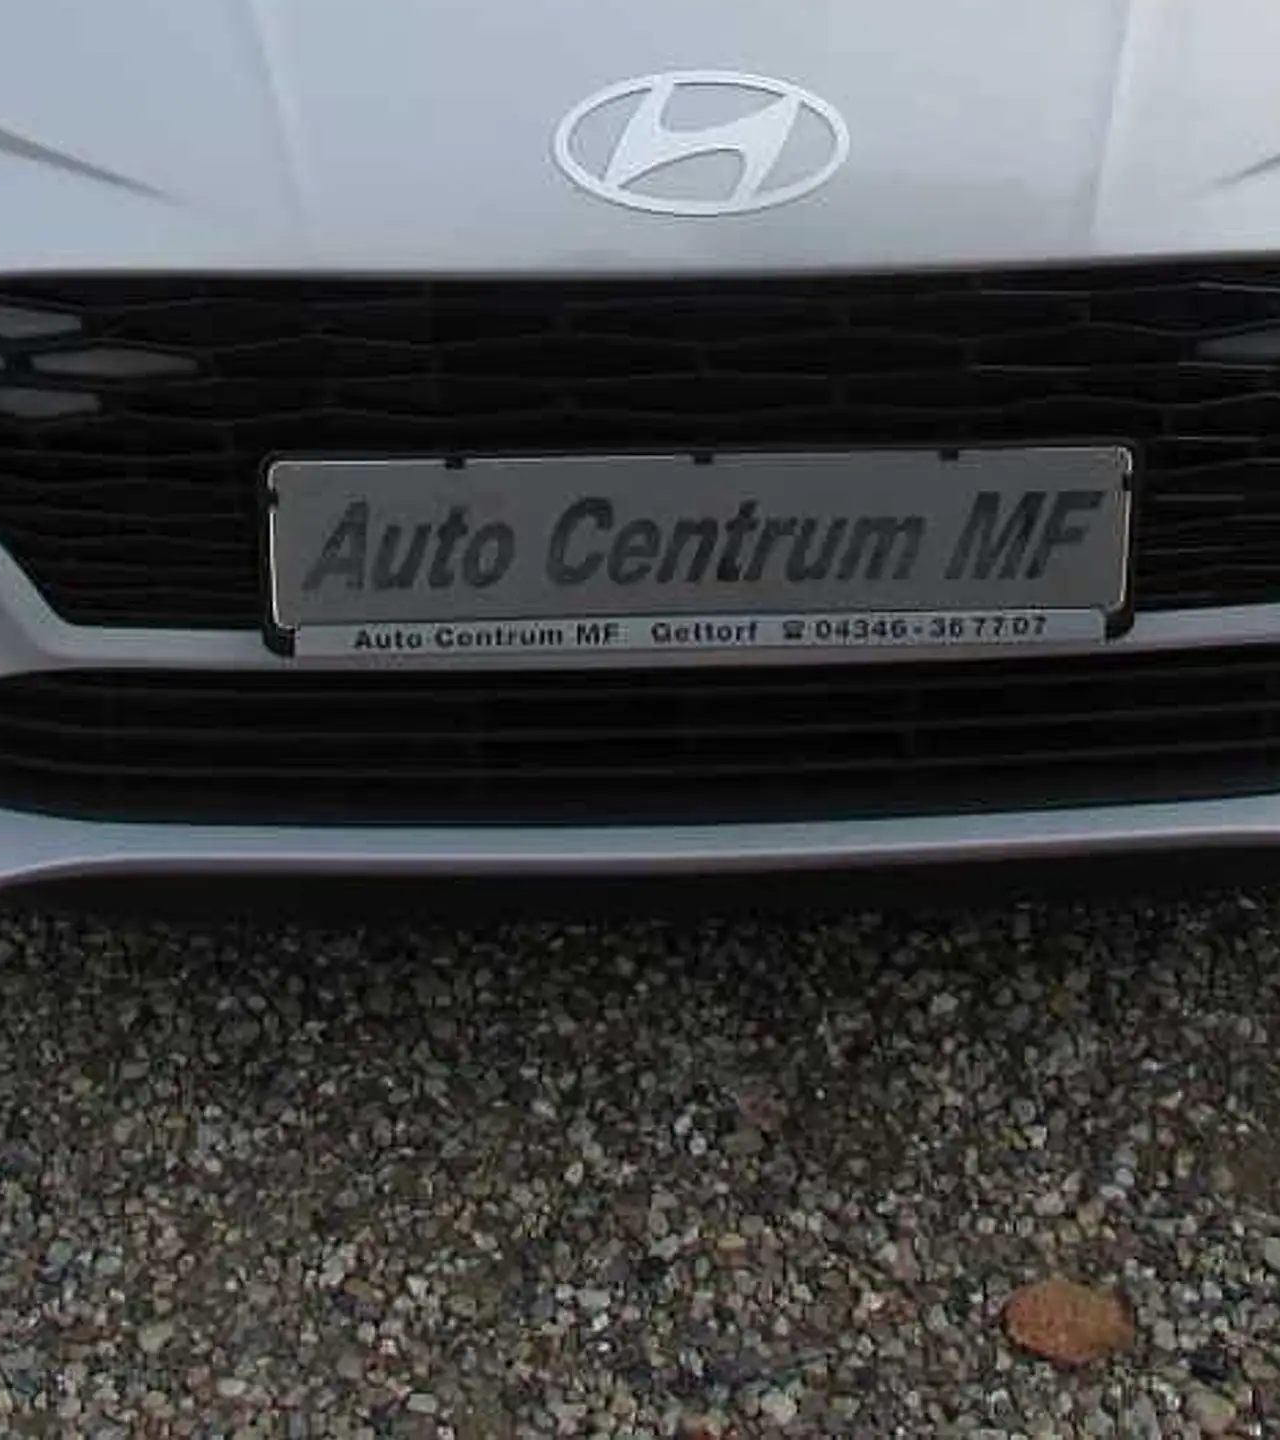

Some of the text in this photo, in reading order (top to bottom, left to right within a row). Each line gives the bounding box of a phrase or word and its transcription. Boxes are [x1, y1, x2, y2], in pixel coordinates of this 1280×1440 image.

[303, 490, 1105, 590] Auto Centrum MF
[354, 627, 424, 649] Auto
[434, 624, 564, 647] Centrum
[575, 623, 620, 646] MF
[651, 620, 759, 644] Gettorf
